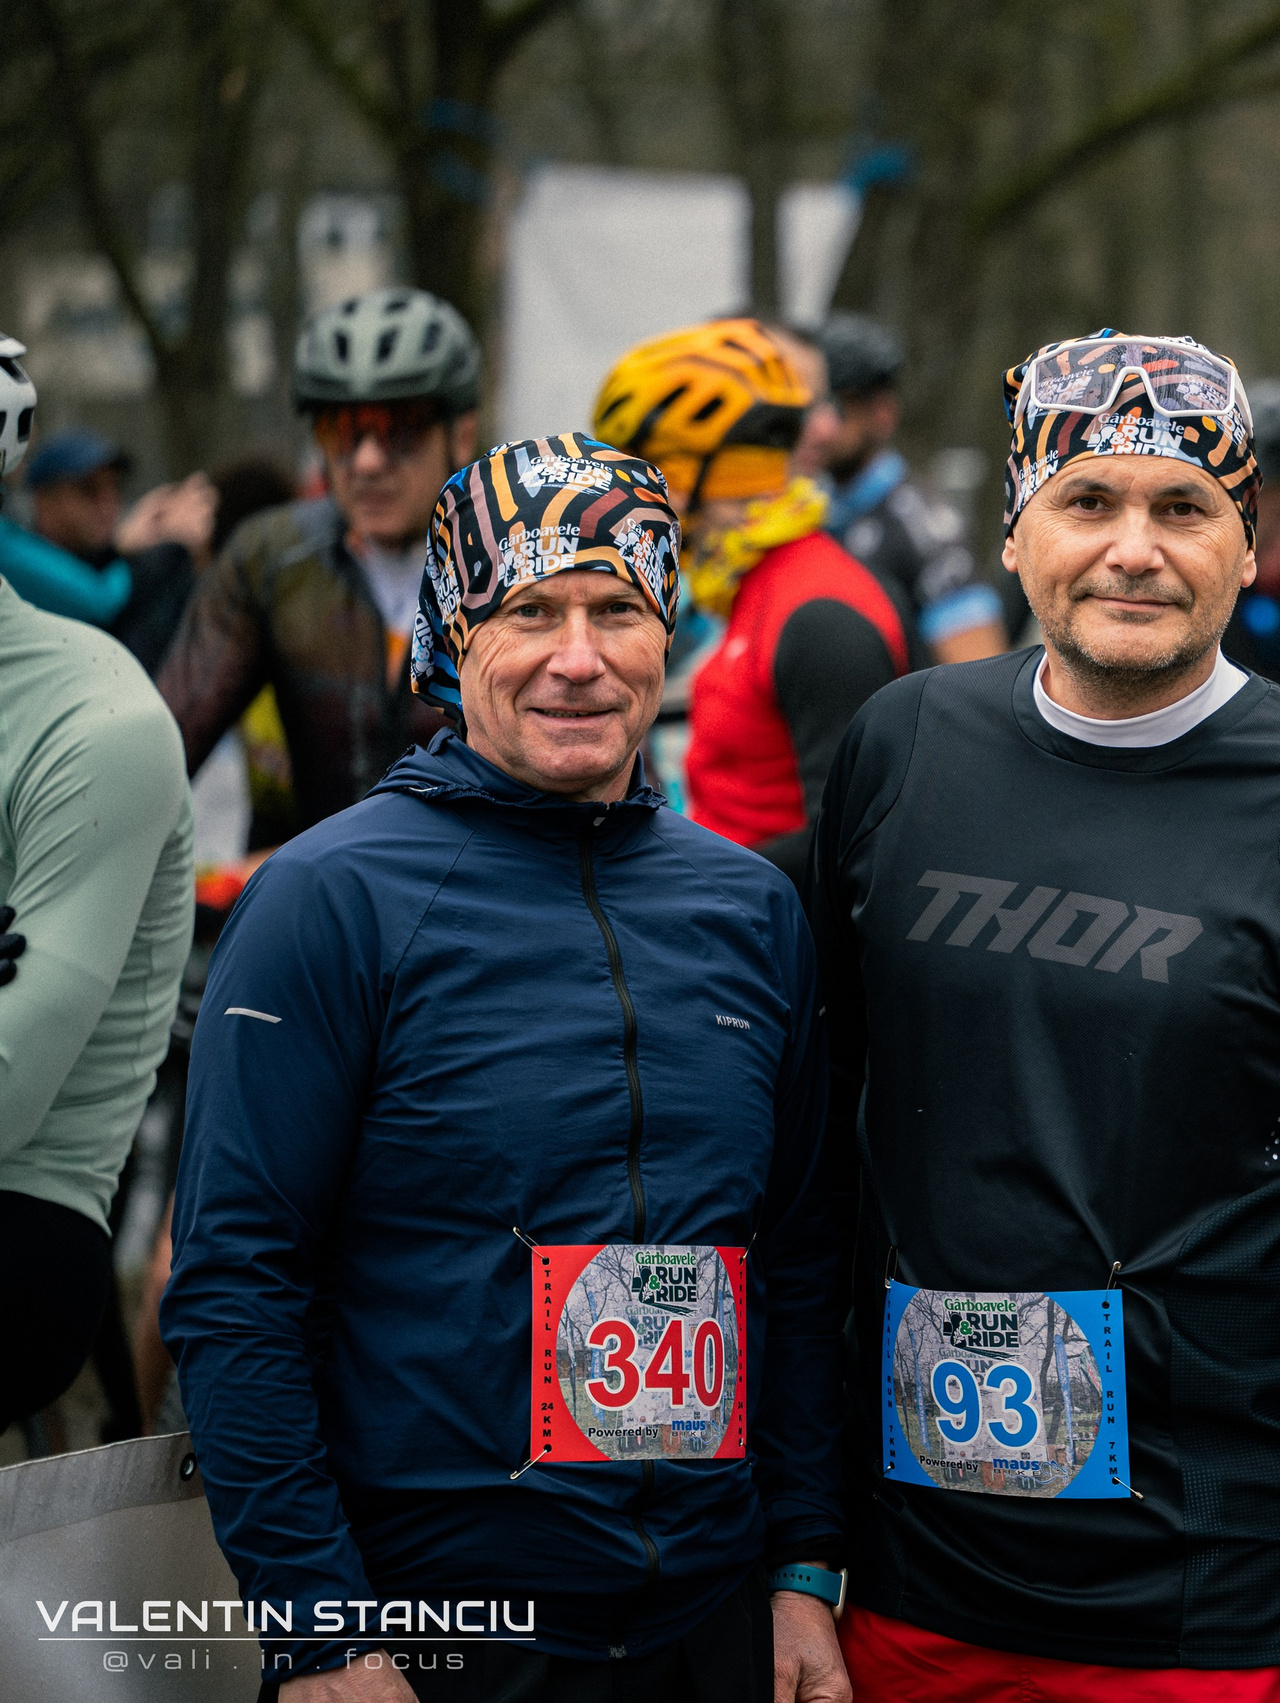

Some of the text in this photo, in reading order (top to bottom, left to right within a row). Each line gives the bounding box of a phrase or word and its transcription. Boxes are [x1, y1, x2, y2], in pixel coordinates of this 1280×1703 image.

[1098, 413, 1185, 434] Gârboavele
[1109, 431, 1127, 445] &
[1122, 425, 1183, 449] RUN
[1116, 441, 1178, 457] RIDE
[530, 454, 613, 473] Gârboavele
[554, 462, 613, 480] RUN
[548, 472, 610, 491] RIDE
[499, 523, 580, 551] Gârboavele
[520, 537, 579, 558] RUN
[513, 553, 525, 569] &
[521, 554, 575, 579] RIDE
[905, 869, 1204, 984] THOR
[715, 1014, 751, 1030] KIPRUN
[635, 1251, 696, 1265] Gârboavele
[648, 1274, 660, 1290] &
[655, 1266, 697, 1284] RUN
[544, 1270, 552, 1331] TRAIL
[656, 1286, 697, 1302] RIDE
[944, 1298, 1016, 1312] Gârboavele
[960, 1321, 973, 1335] &
[966, 1313, 1018, 1331] RUN
[968, 1331, 1019, 1348] RIDE
[1103, 1314, 1112, 1372] TRAIL
[544, 1349, 552, 1383] RUN
[587, 1318, 724, 1409] 340
[932, 1360, 1040, 1448] 93
[1106, 1391, 1115, 1424] RUN
[588, 1427, 658, 1438] Powered by
[672, 1420, 706, 1431] maus
[919, 1455, 979, 1473] Powered by
[992, 1458, 1040, 1471] maus
